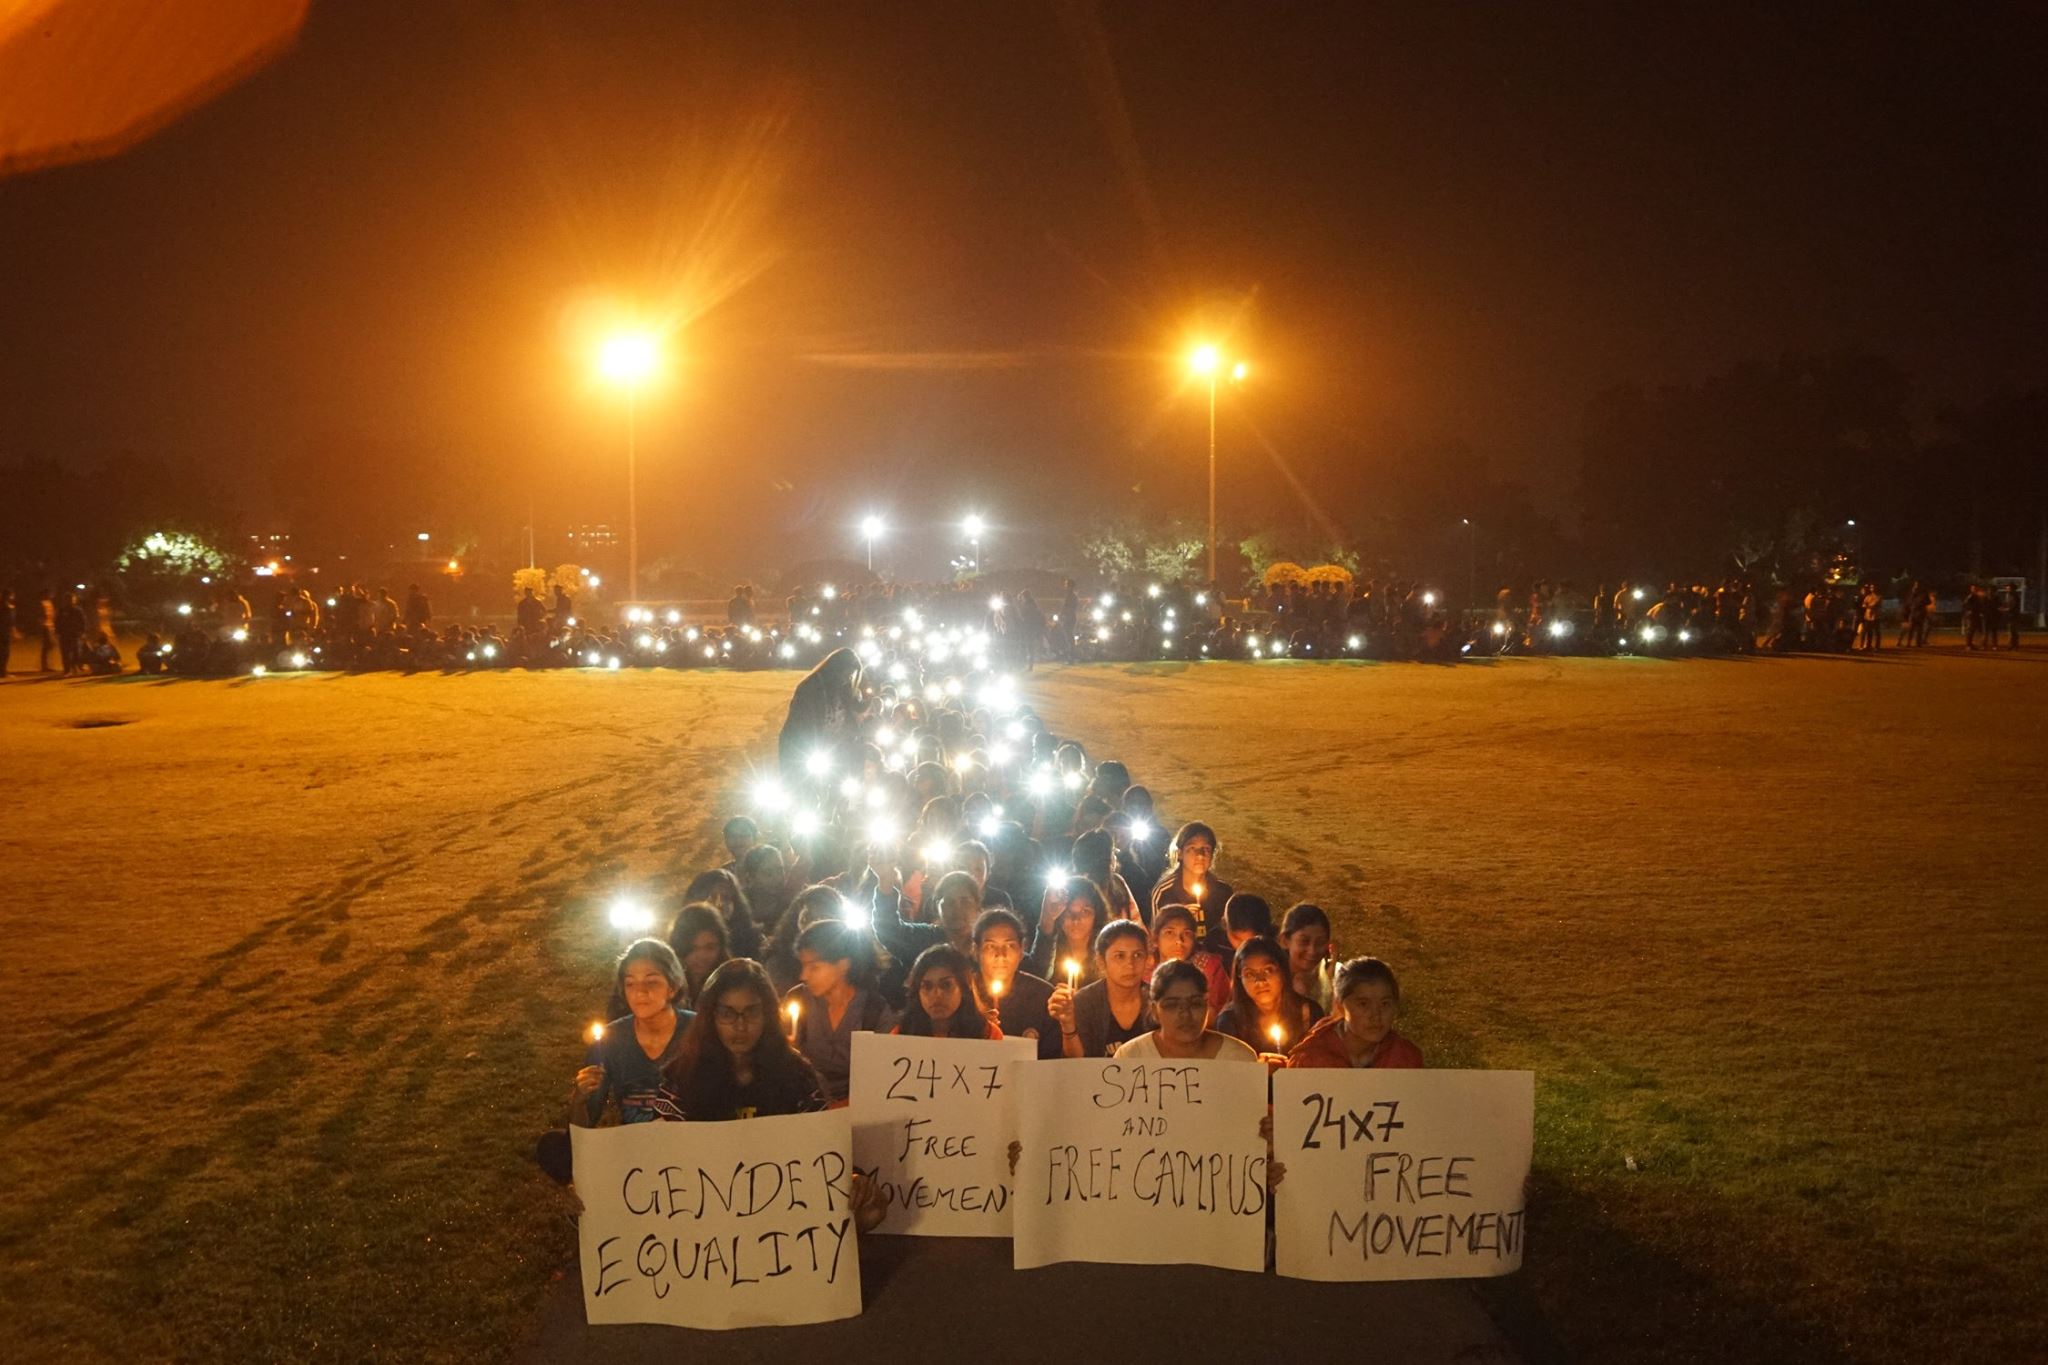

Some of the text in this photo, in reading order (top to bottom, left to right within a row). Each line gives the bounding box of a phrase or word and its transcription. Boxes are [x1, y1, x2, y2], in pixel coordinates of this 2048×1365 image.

[1093, 1065, 1203, 1110] SAFE
[1121, 1116, 1169, 1138] AND
[623, 1151, 851, 1219] GENDER
[1046, 1146, 1266, 1216] FREE CAMPUS
[1364, 1152, 1476, 1204] FREE
[595, 1218, 851, 1299] EQUALITY
[1328, 1210, 1524, 1260] MOVEMENT
